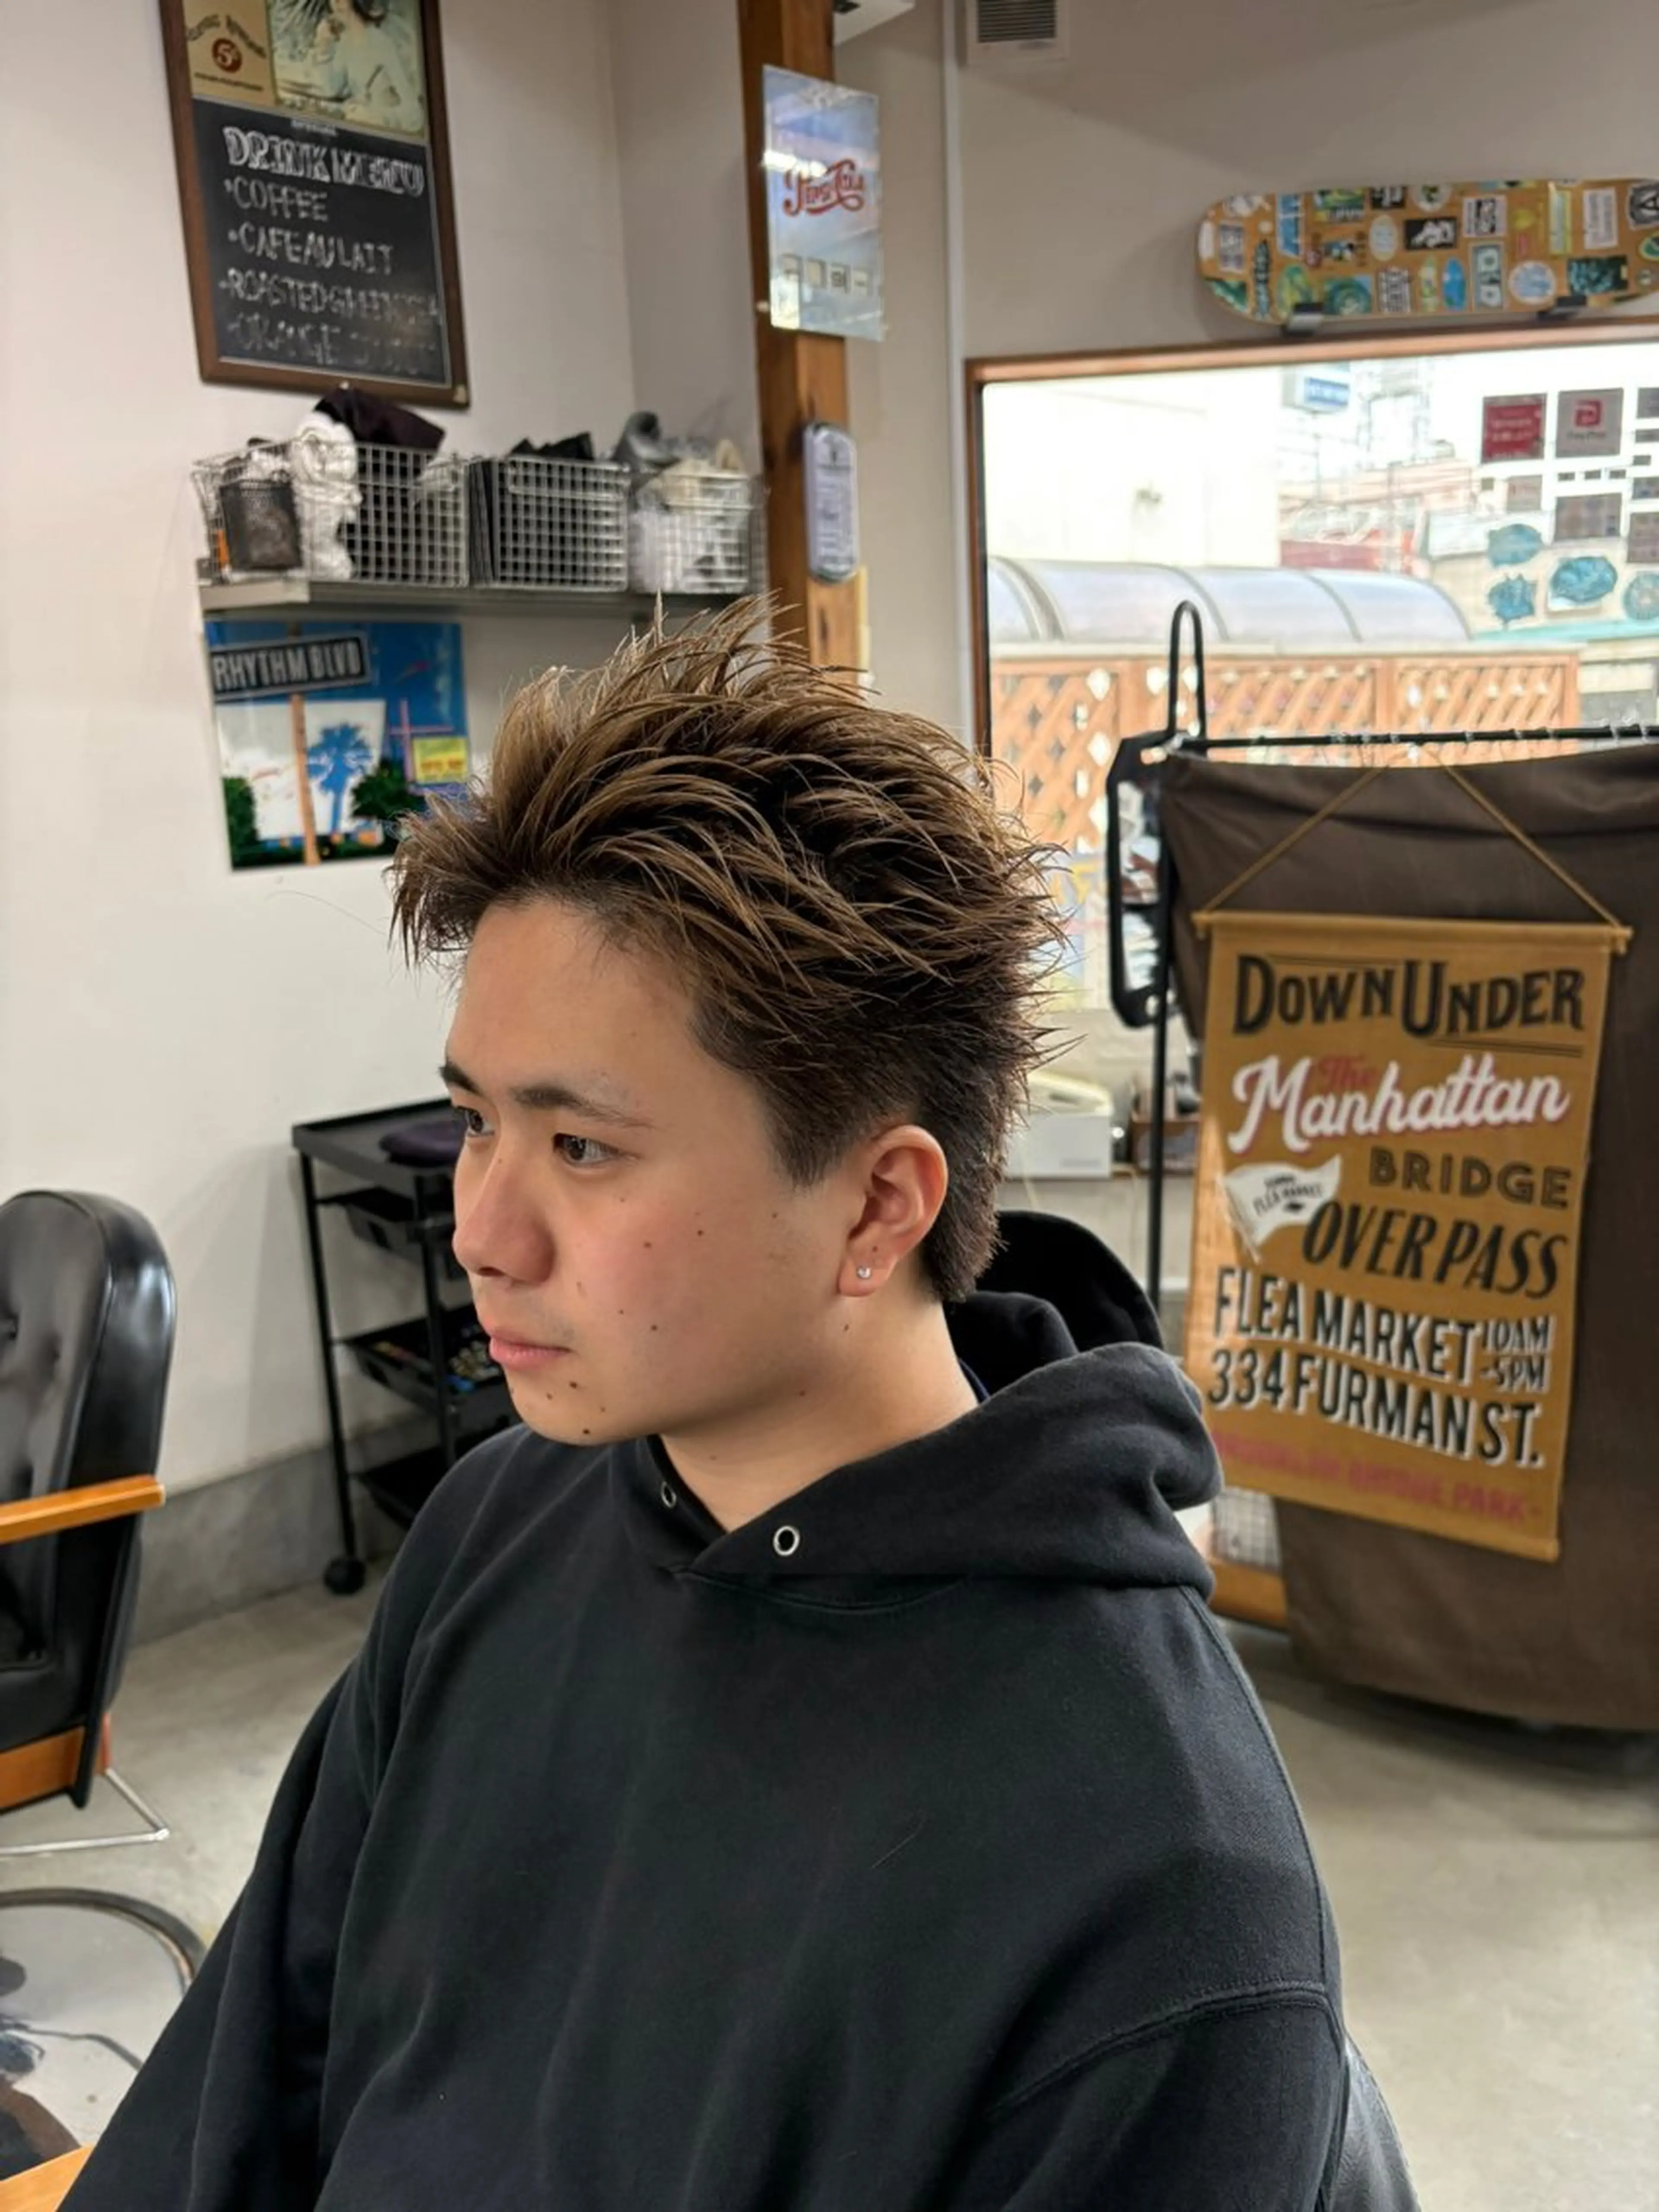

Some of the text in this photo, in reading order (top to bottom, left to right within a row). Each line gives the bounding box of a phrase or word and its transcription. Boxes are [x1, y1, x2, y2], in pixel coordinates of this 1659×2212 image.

[233, 175, 329, 222] COFFEE
[213, 640, 362, 691] RHYTHM BLVD
[1227, 1052, 1572, 1155] Manhattan
[1369, 1146, 1573, 1210] BRIDGE
[1214, 1266, 1305, 1342] FLEA
[1312, 1287, 1481, 1387] MARKET
[1208, 1348, 1291, 1411] 334
[1291, 1352, 1478, 1460] FURMAN
[1478, 1402, 1547, 1468] ST.
